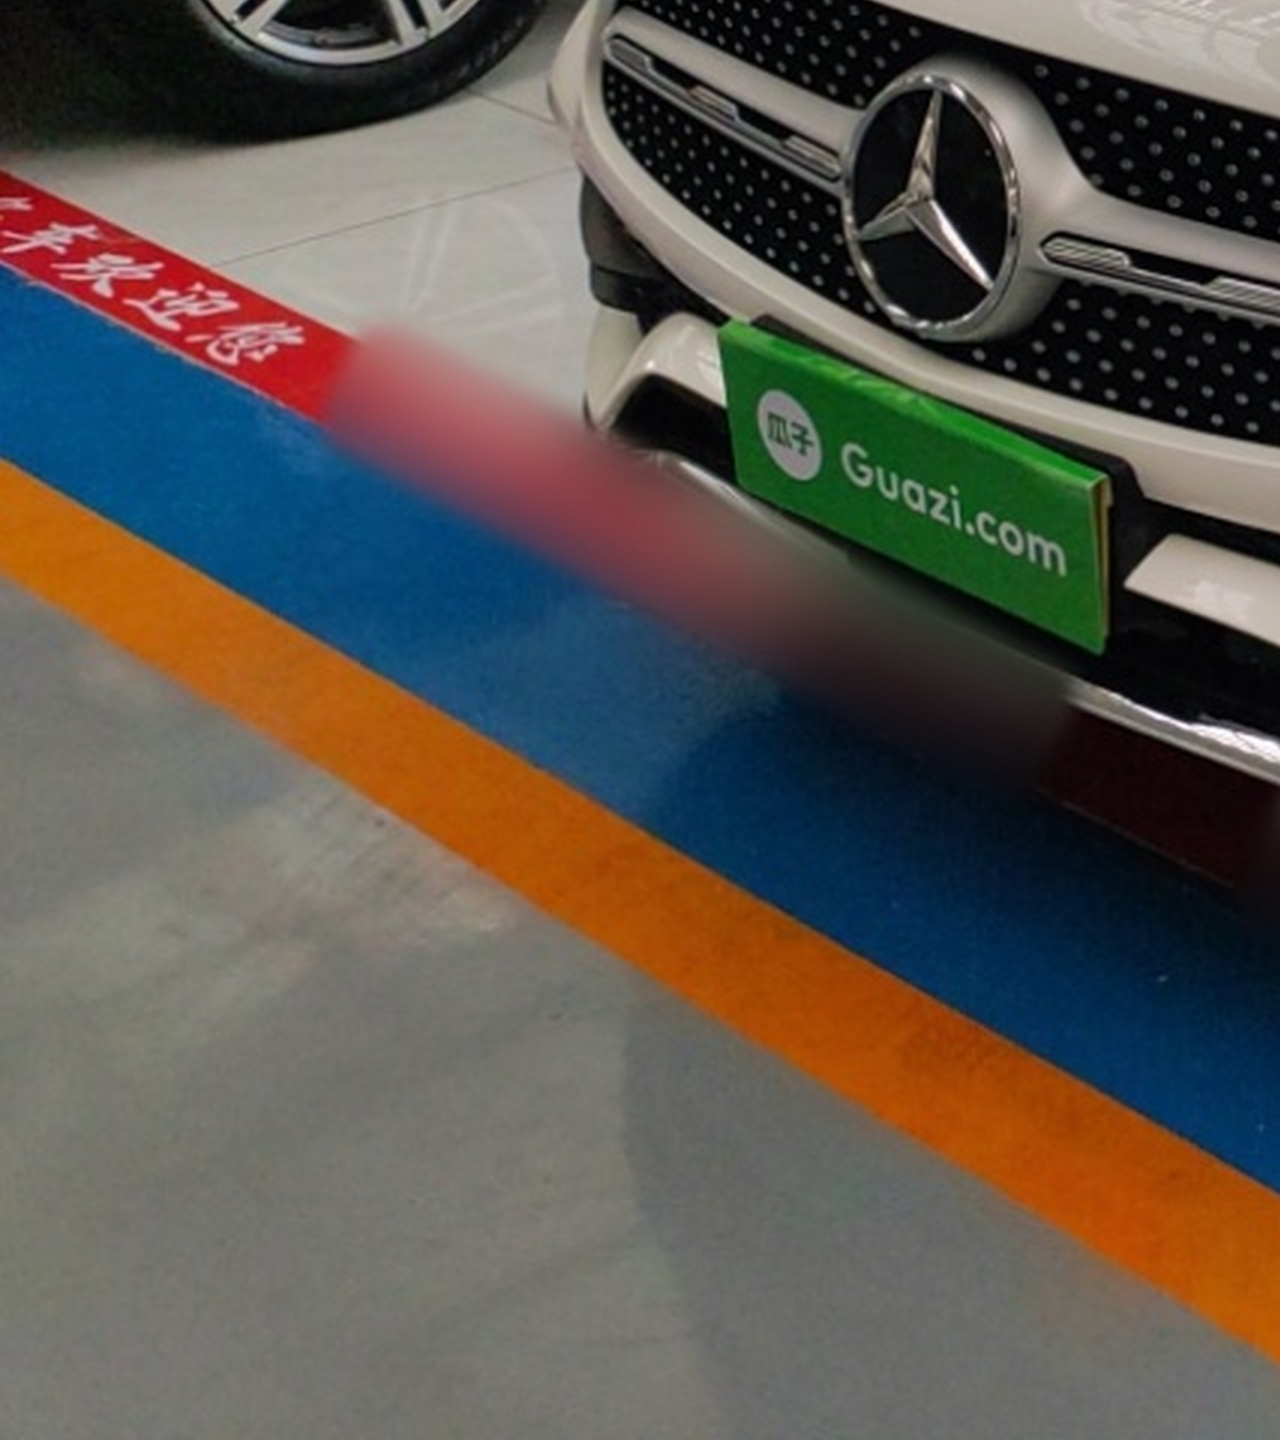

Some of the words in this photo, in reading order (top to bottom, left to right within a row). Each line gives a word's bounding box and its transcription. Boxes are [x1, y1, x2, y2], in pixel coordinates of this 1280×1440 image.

[0, 197, 304, 366] 车欢迎您
[767, 411, 814, 456] 瓜子
[840, 441, 1067, 576] Guazi.com
